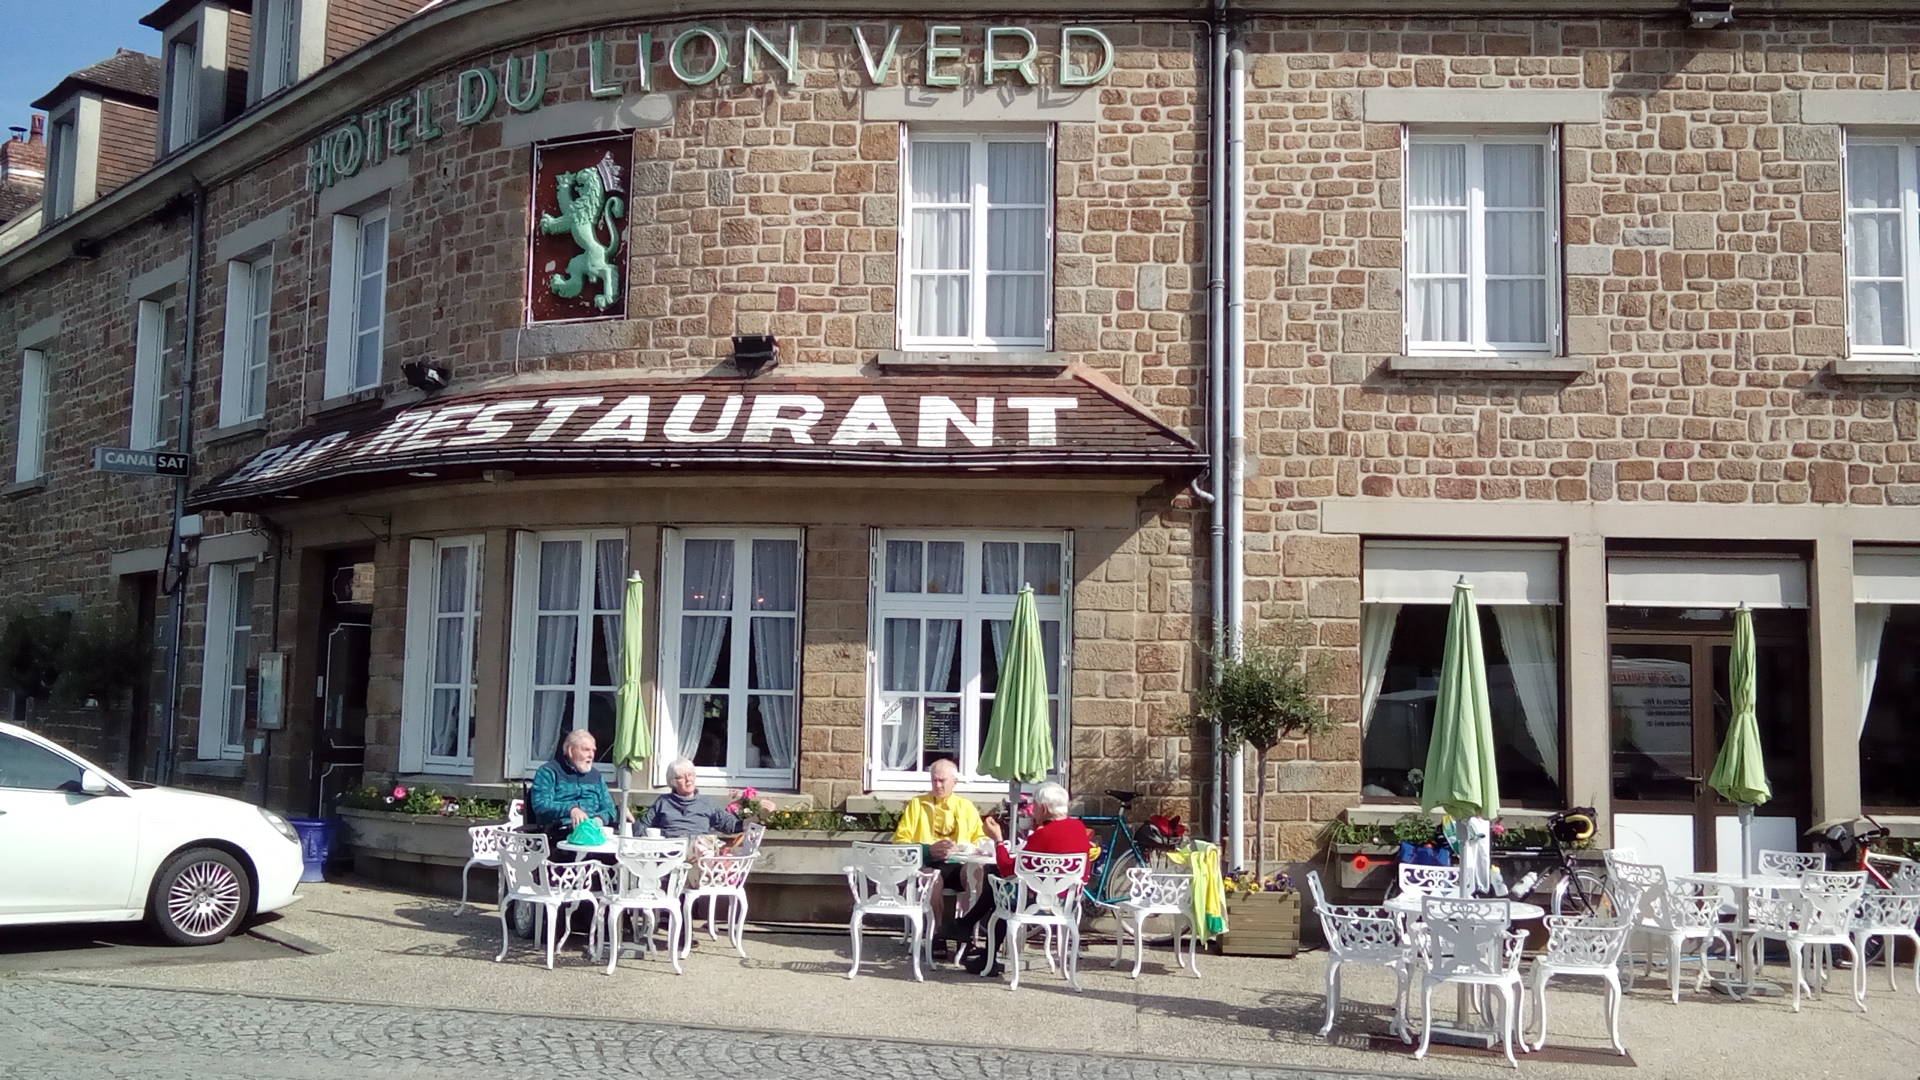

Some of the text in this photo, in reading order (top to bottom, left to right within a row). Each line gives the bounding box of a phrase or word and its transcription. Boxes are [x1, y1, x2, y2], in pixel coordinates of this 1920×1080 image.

[456, 51, 548, 125] DU
[589, 24, 799, 97] LION
[851, 24, 1115, 85] VERD
[217, 394, 1079, 487] BAR RESTAURANT
